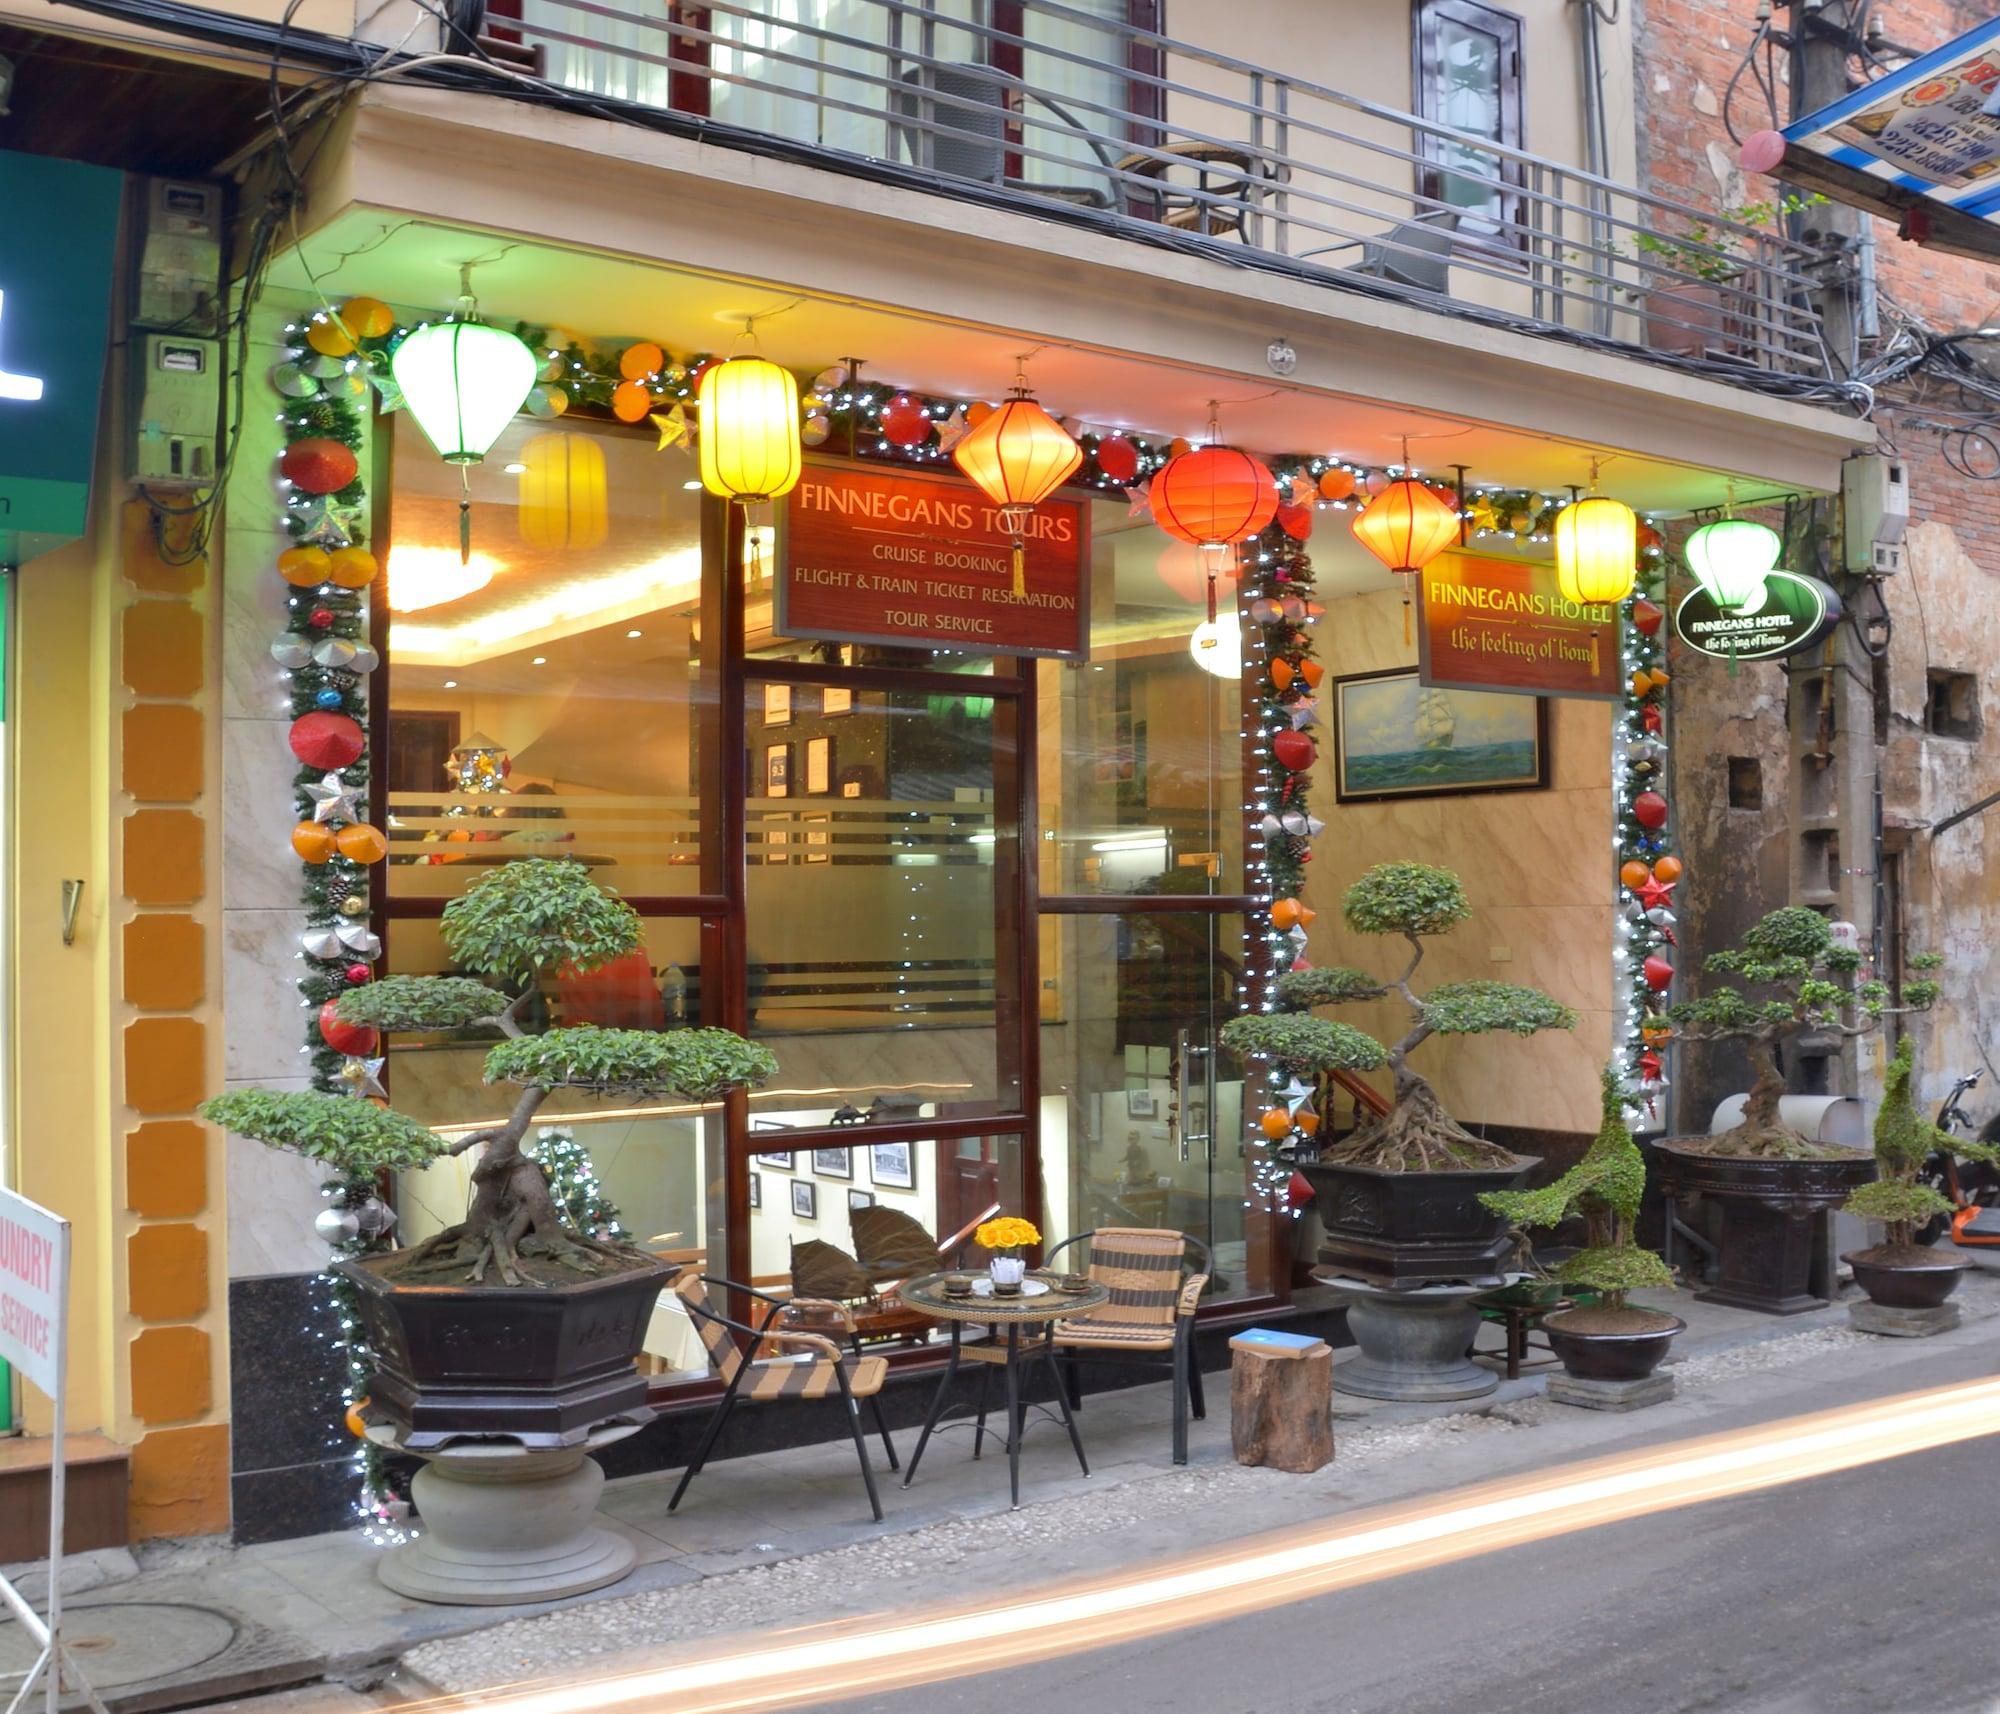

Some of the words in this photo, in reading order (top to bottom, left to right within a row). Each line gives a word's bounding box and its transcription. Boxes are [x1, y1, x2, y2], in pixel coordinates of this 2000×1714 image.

[801, 483, 972, 530] FINNEGANS
[981, 507, 1072, 542] TOURS
[872, 544, 927, 564] CRUISE
[935, 551, 1008, 574] BOOKING
[795, 567, 853, 588] FLIGHT
[856, 574, 871, 590] &
[872, 576, 918, 595] TRAIN
[925, 581, 976, 601] TICKET
[1431, 582, 1545, 615] FINNEGANS
[884, 609, 929, 628] TOUR
[935, 615, 994, 634] SERVICE
[1692, 617, 1754, 633] FINNEGANS
[1755, 614, 1793, 628] HOTEL
[1451, 626, 1477, 652] the
[1481, 629, 1536, 663] feeling
[1539, 636, 1557, 658] of
[1705, 638, 1720, 650] the
[1721, 635, 1750, 651] feing
[1761, 633, 1786, 647] home
[1, 1293, 50, 1360] SERVICE
